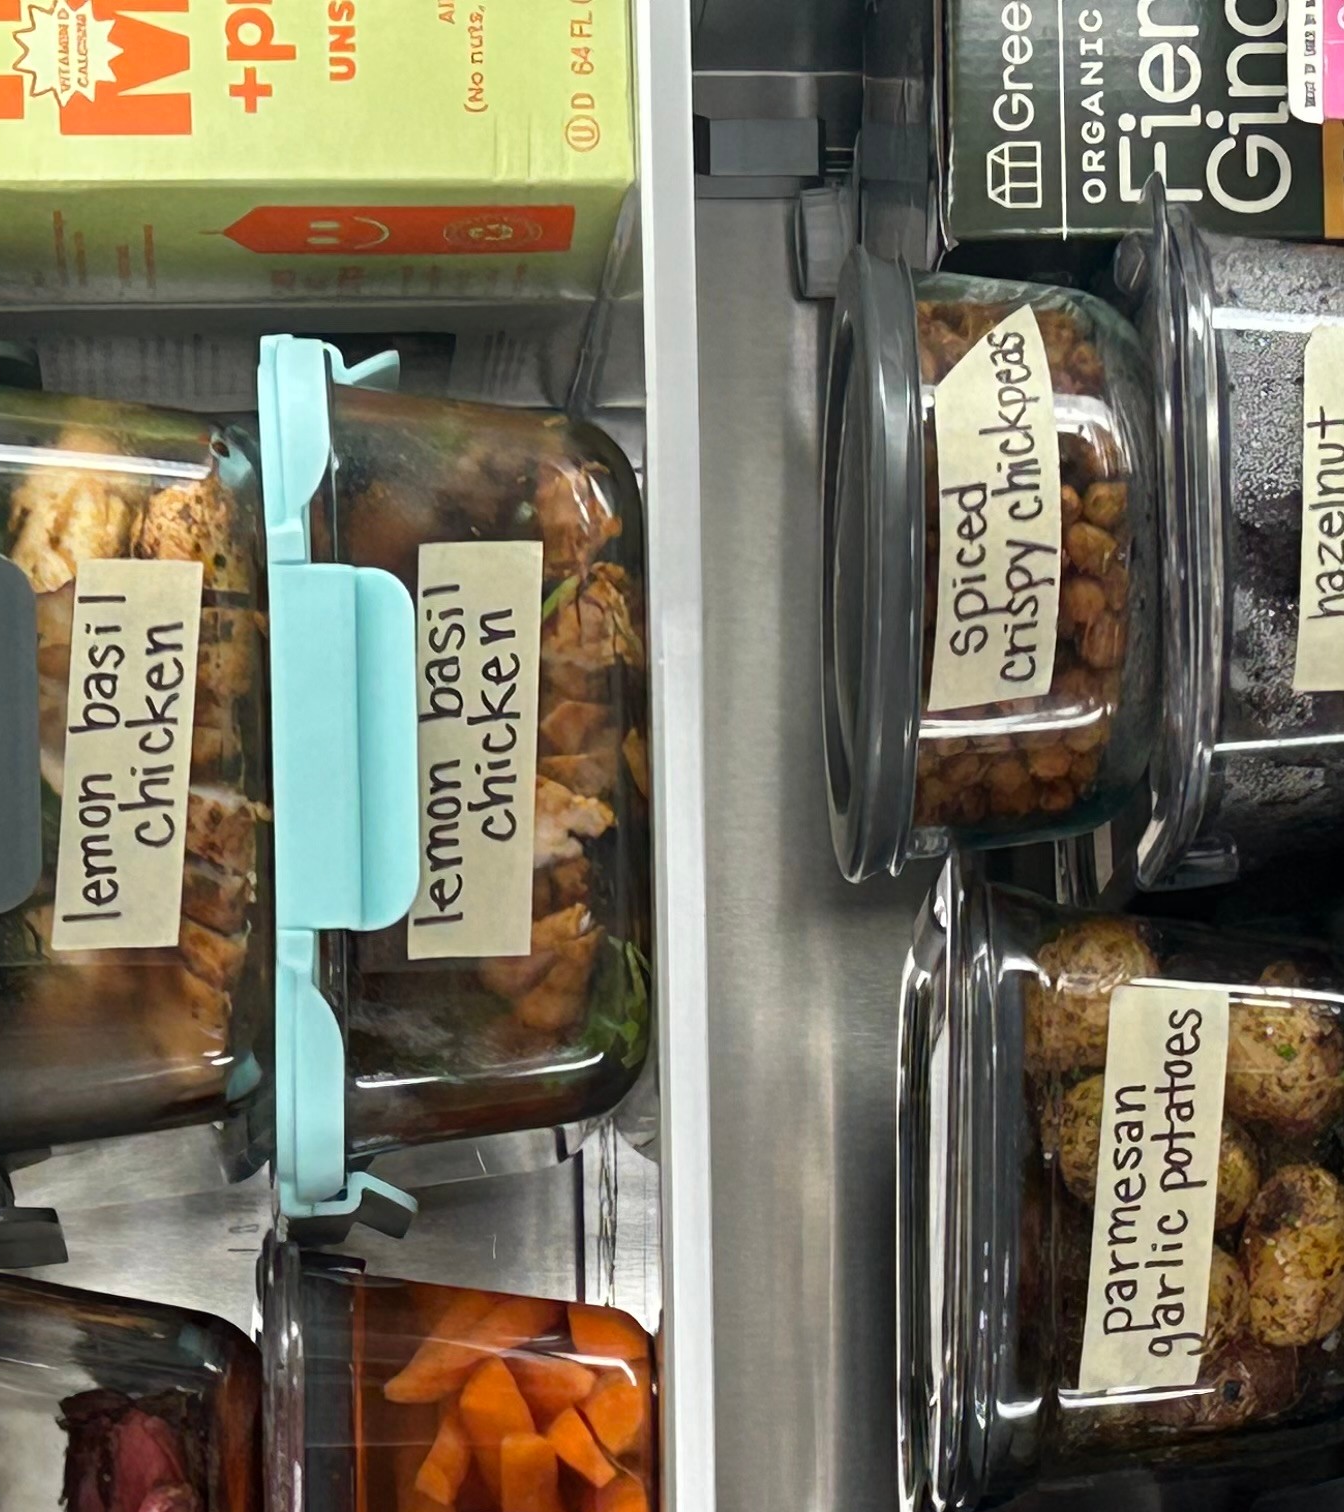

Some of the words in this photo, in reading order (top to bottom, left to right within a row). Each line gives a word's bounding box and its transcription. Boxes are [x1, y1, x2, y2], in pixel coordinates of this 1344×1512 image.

[224, 0, 297, 113] +p
[569, 46, 596, 76] 64
[991, 2, 1036, 132] Gree
[1078, 8, 1108, 204] ORGANIC
[978, 331, 1043, 522] chickpeas
[67, 593, 128, 734] basil
[417, 583, 465, 723] basil
[995, 539, 1058, 682] crispy
[117, 621, 185, 848] chicken
[465, 606, 521, 843] chicken
[61, 772, 123, 923] lemon
[412, 759, 464, 928] lemon
[1149, 1007, 1207, 1192] potatoes
[1102, 1084, 1158, 1334] parmesan
[1144, 1209, 1204, 1358] garlic
